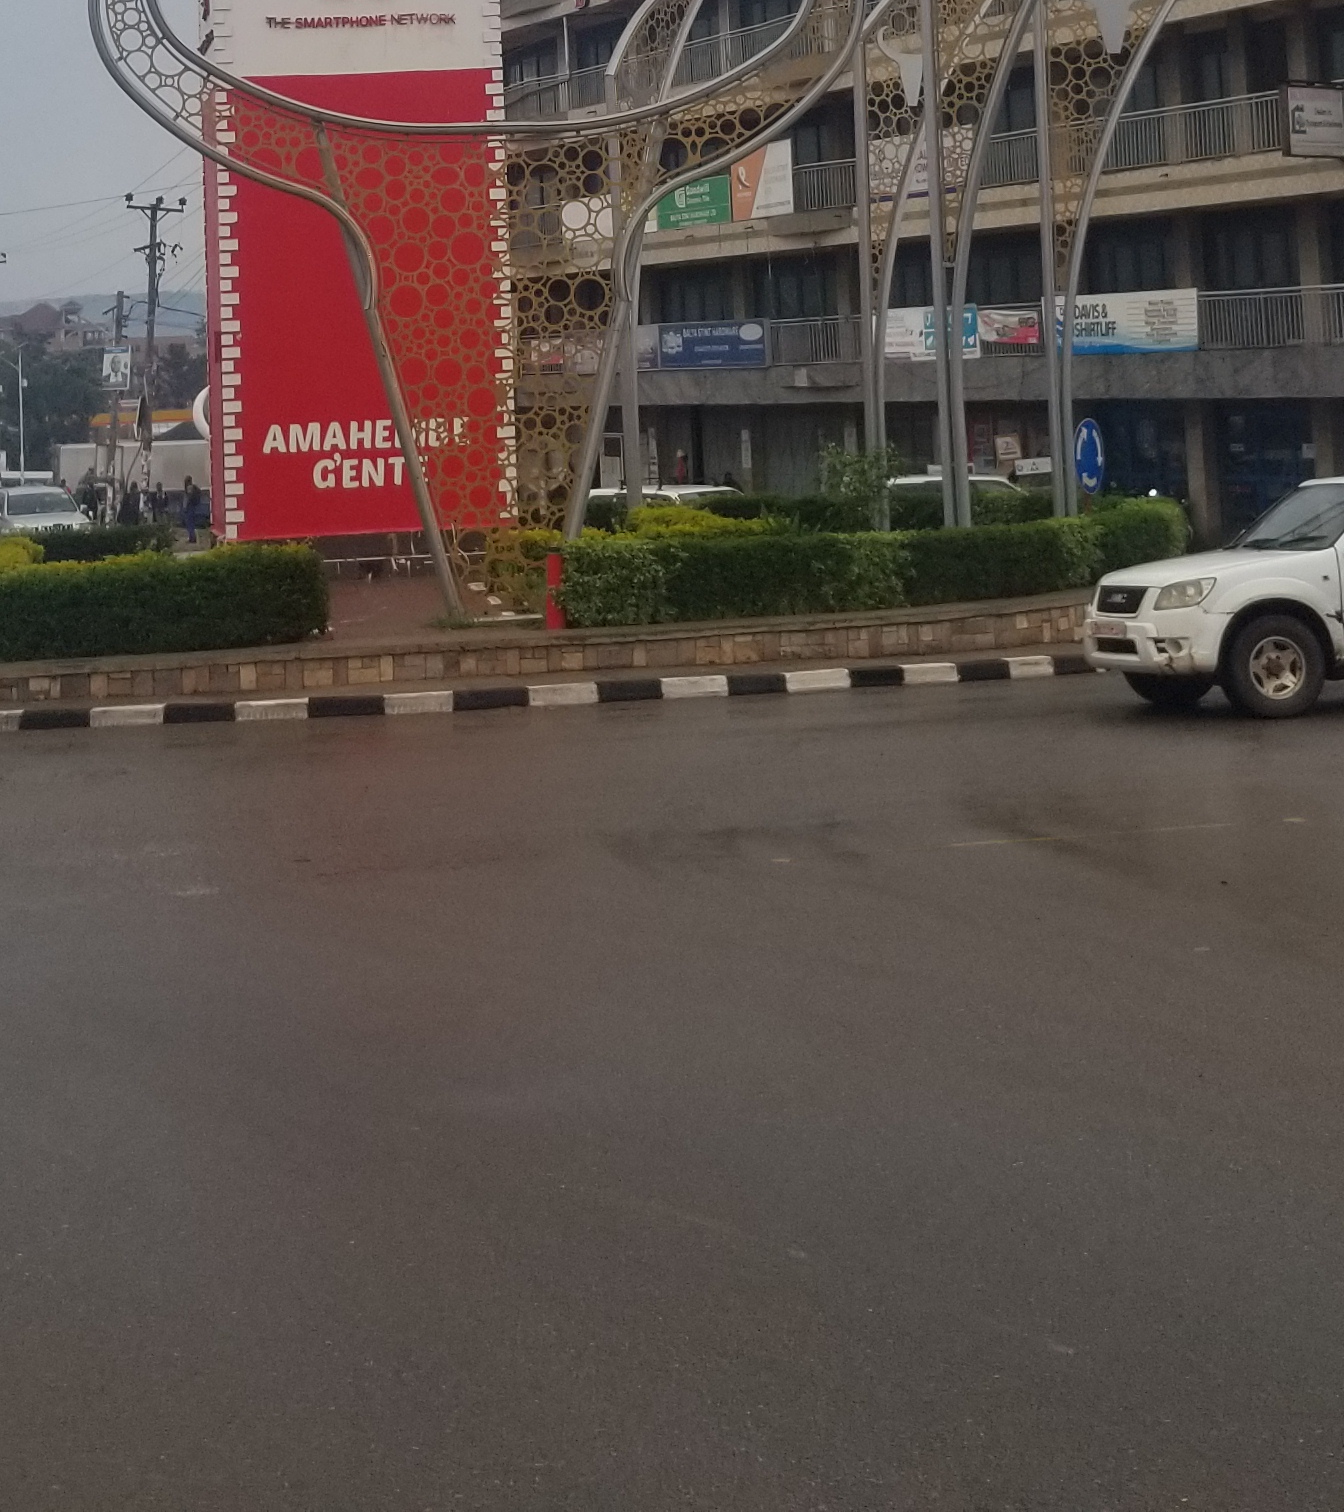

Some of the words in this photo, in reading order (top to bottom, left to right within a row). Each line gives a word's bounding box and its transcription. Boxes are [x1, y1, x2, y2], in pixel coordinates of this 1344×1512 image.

[266, 16, 291, 29] THE
[295, 14, 387, 29] SMARTPHONE
[390, 12, 456, 26] NETWORK
[1074, 304, 1100, 320] DAVIS
[1100, 303, 1108, 319] &
